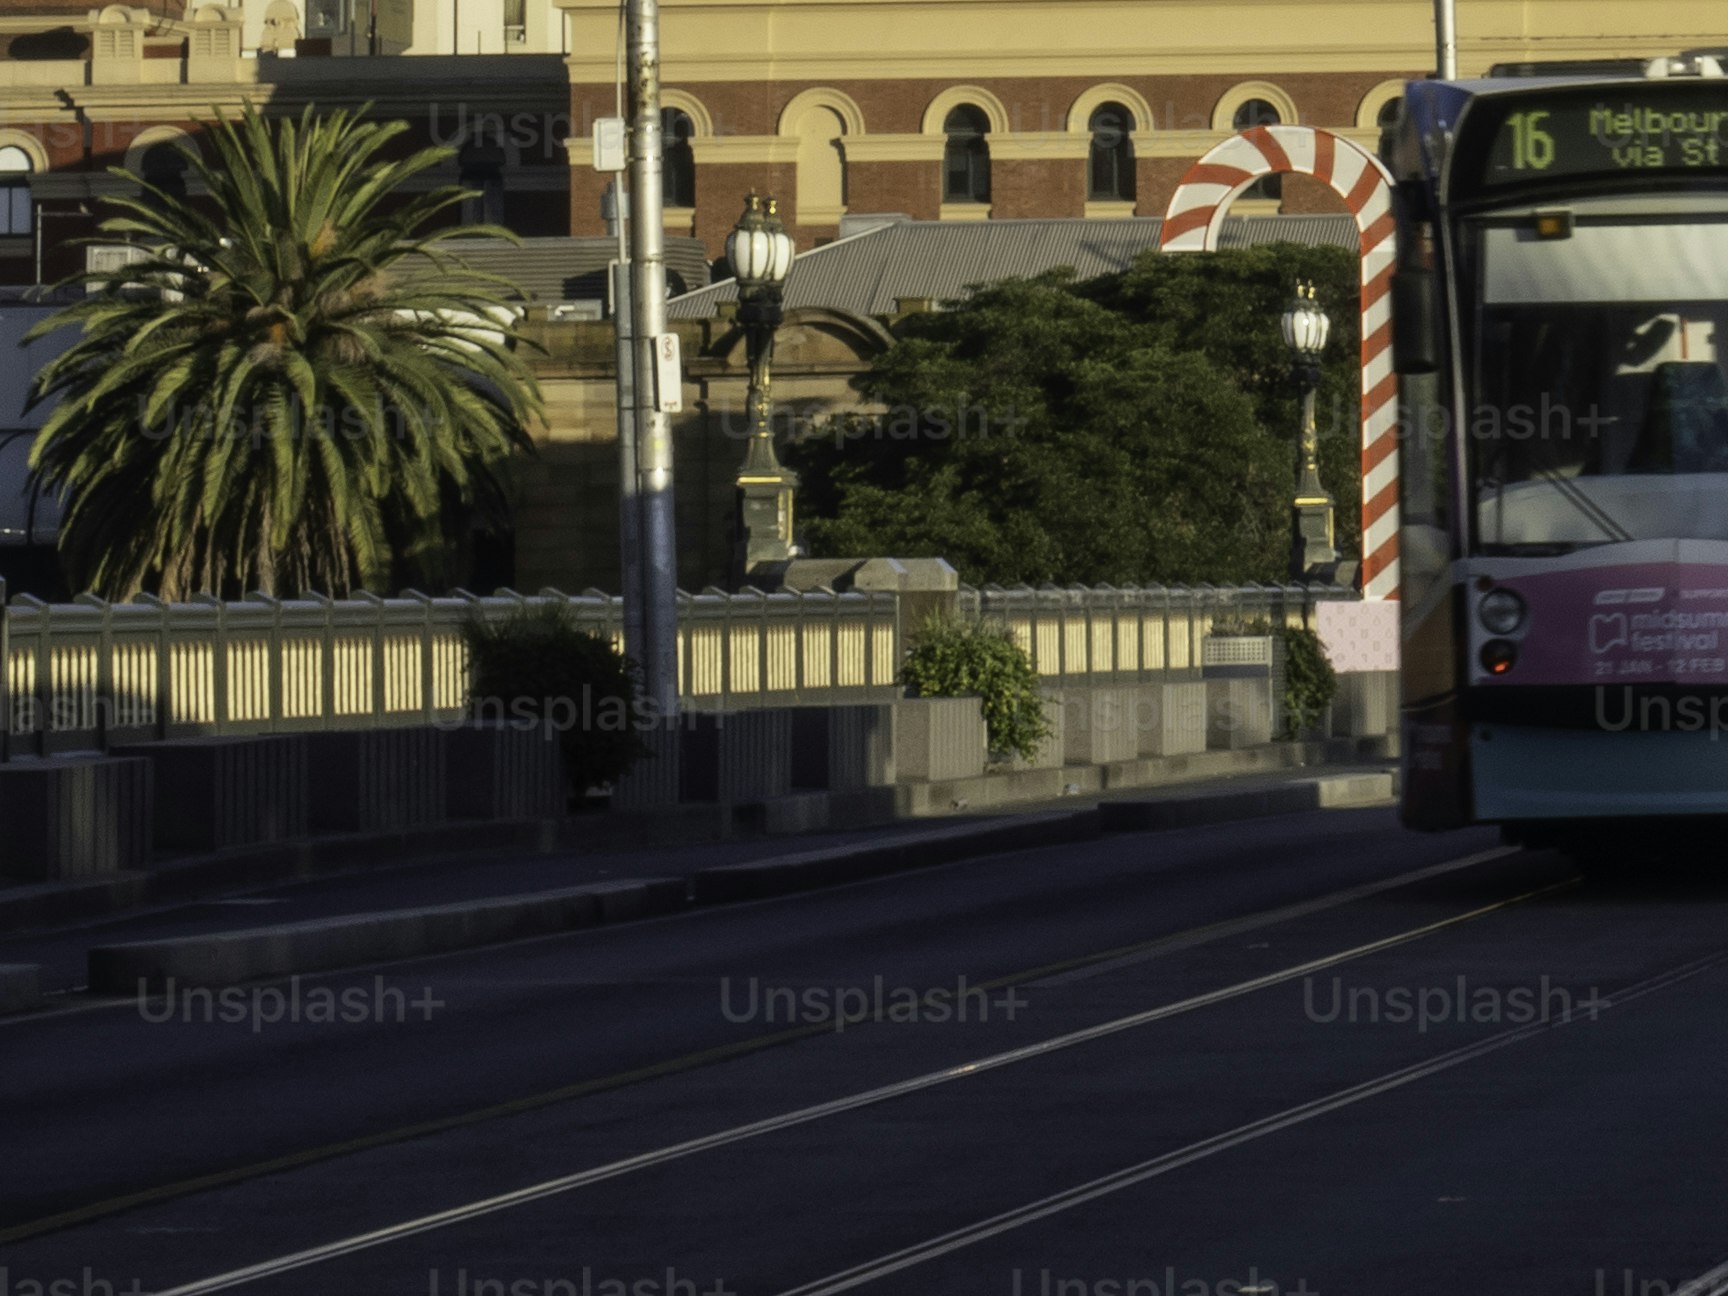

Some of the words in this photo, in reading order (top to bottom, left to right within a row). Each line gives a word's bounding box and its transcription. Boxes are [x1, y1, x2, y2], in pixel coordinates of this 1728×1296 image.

[1505, 111, 1556, 170] 16
[1612, 141, 1664, 166] via
[1681, 136, 1719, 166] St
[1631, 631, 1719, 652] festival
